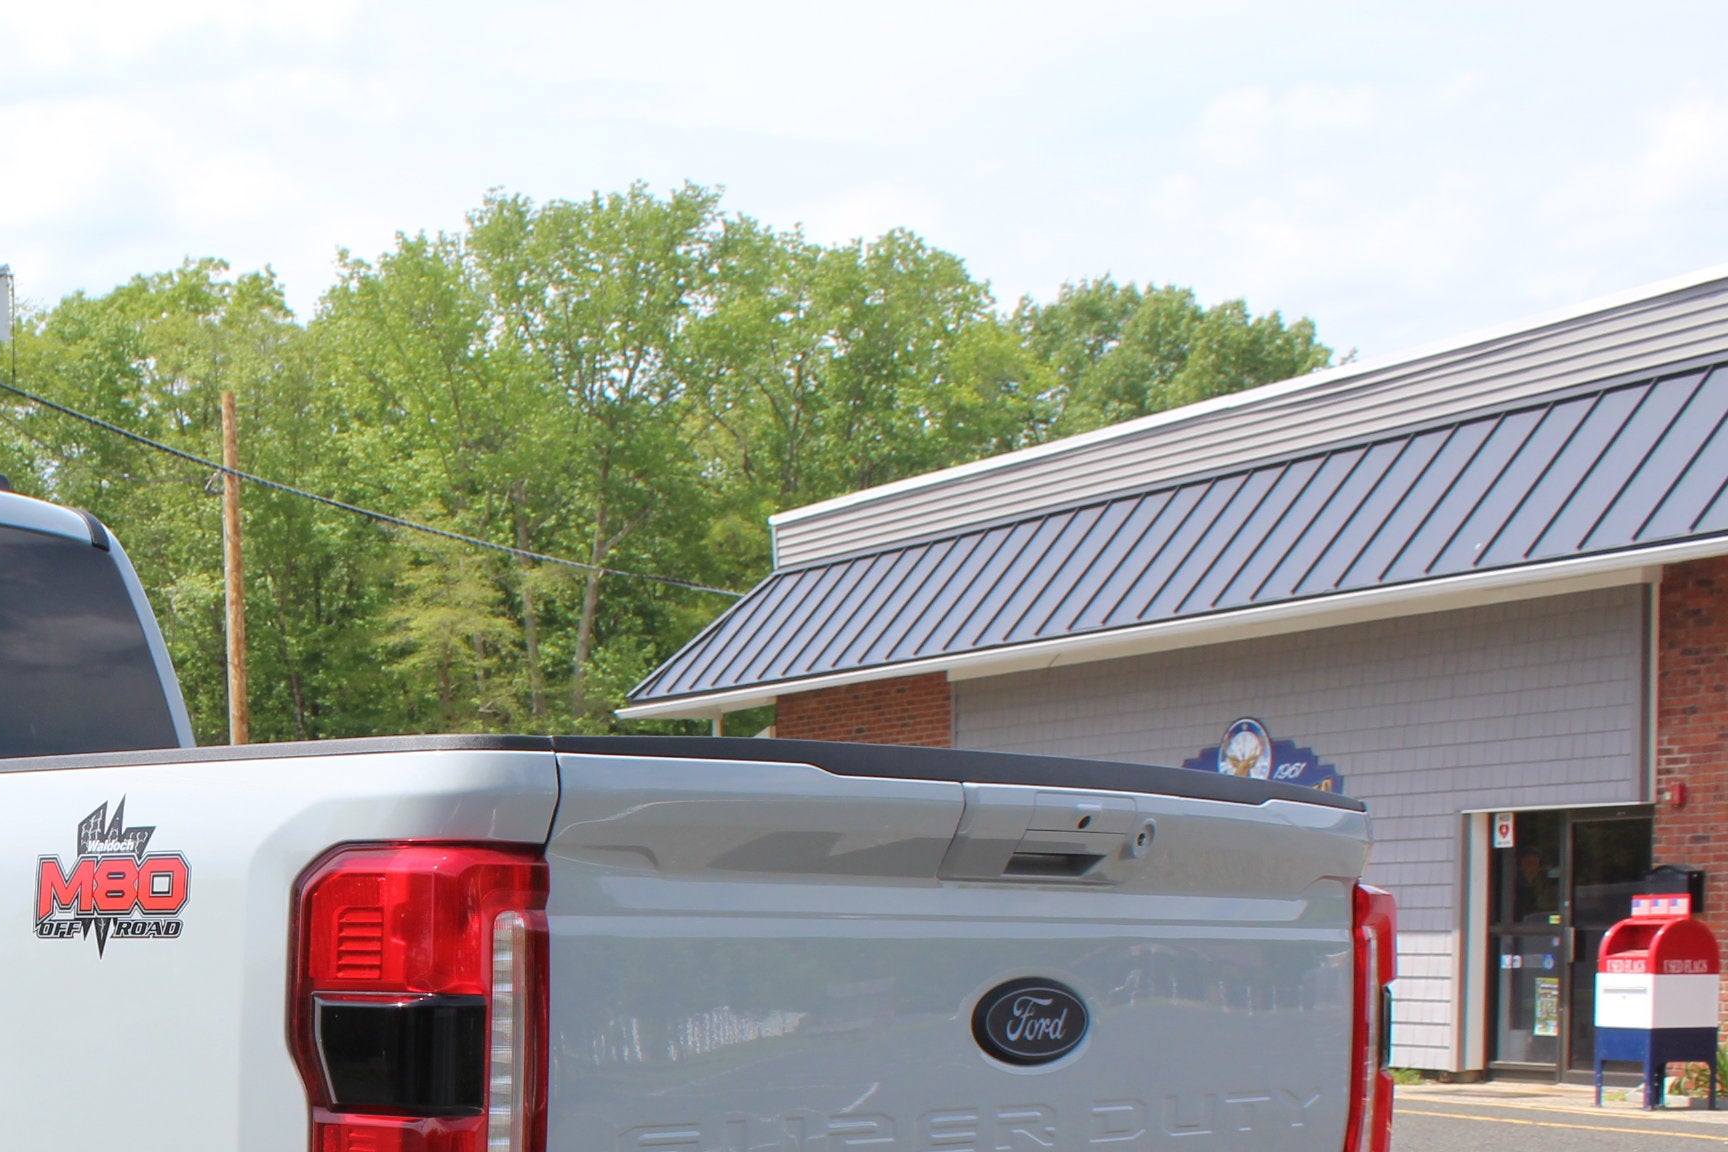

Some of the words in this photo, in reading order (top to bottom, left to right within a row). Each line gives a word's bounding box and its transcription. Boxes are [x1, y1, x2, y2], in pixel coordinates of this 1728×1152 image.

[1273, 762, 1308, 779] 1961
[87, 839, 134, 853] Waldoch
[35, 853, 189, 922] M80
[39, 921, 82, 936] OFF
[115, 920, 181, 936] ROAD
[1006, 995, 1068, 1042] Ford
[1089, 1086, 1322, 1143] DUTY
